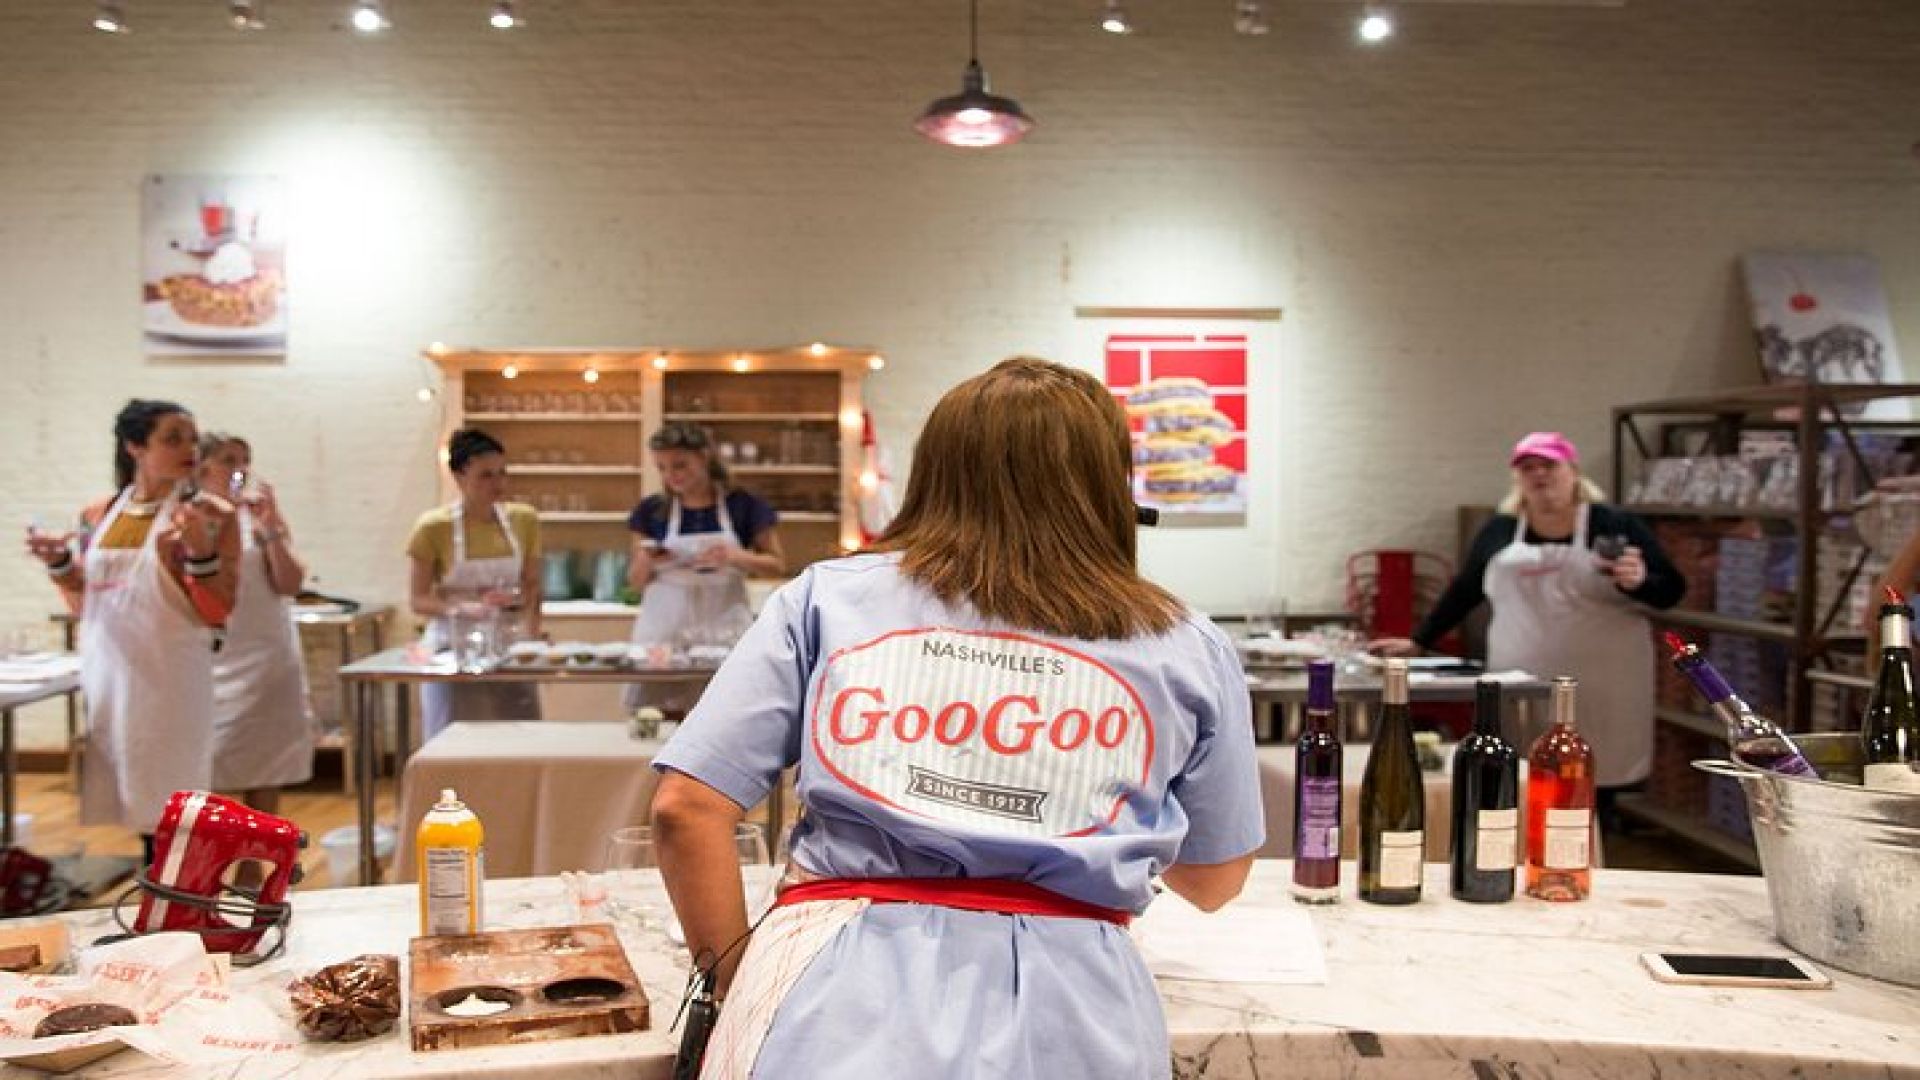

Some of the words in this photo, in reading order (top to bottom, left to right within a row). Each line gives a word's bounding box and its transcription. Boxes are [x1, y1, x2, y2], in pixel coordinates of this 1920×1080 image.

[921, 638, 1064, 676] NASHVILLE'S
[830, 687, 1128, 754] GooGoo
[923, 777, 981, 804] SINCE
[987, 793, 1027, 812] 1912
